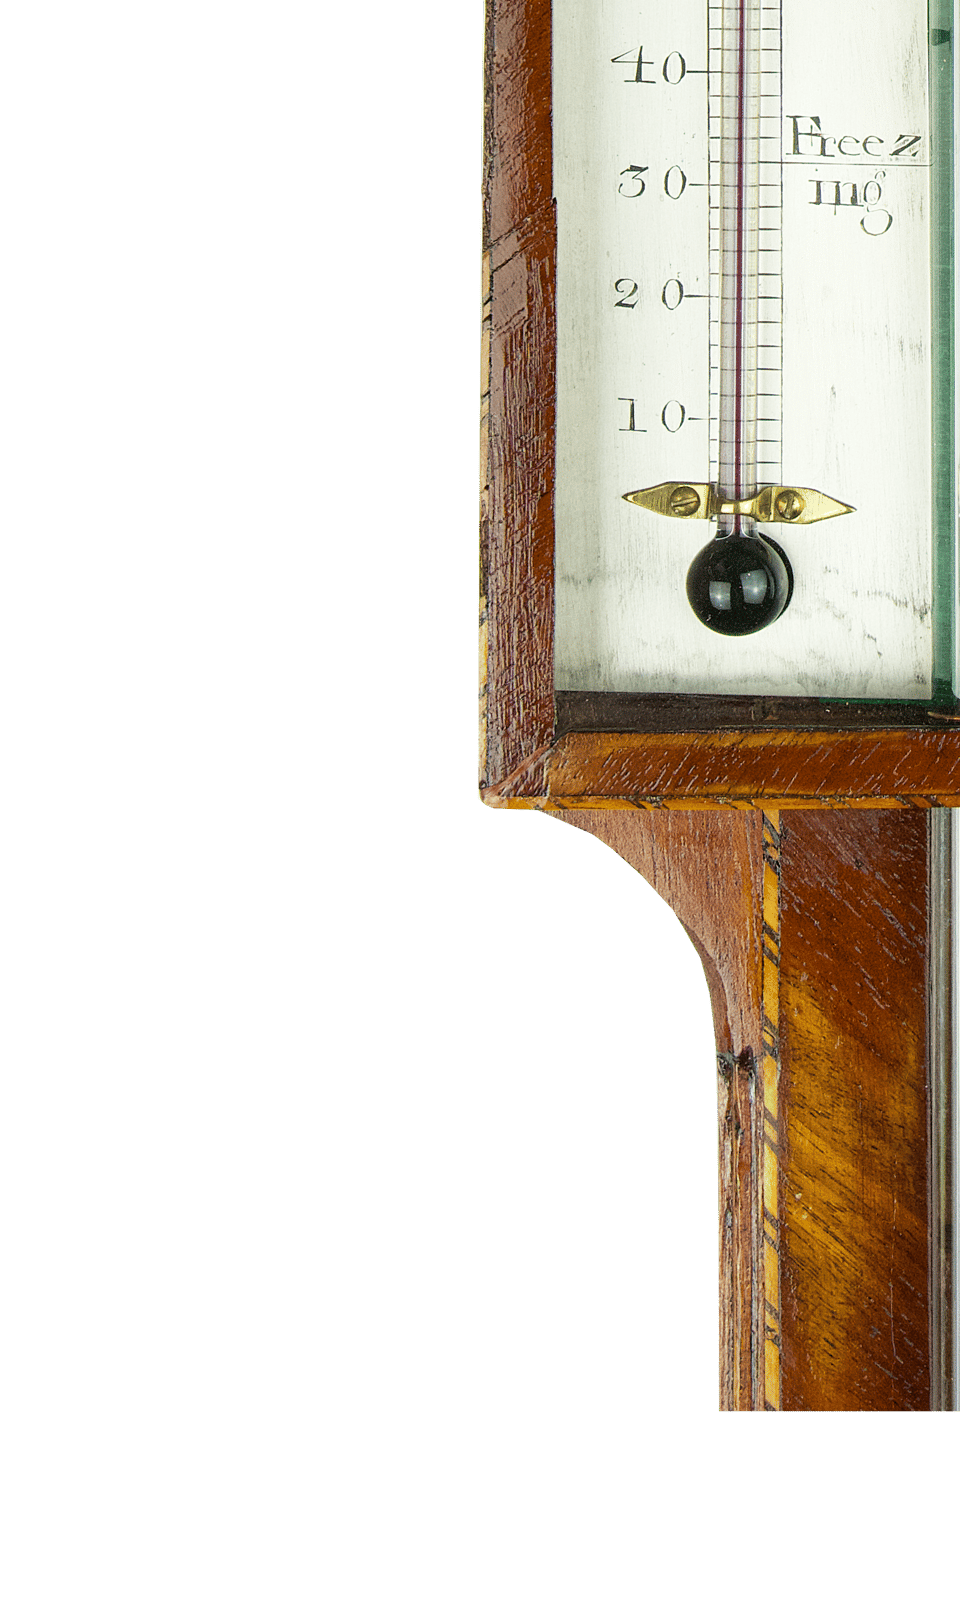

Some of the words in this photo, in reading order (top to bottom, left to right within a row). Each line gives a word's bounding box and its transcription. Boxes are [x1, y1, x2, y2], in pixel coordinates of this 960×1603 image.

[610, 45, 687, 86] 40
[785, 114, 922, 158] Freez
[618, 162, 687, 200] 30
[808, 168, 894, 237] ing
[613, 278, 684, 311] 20
[617, 396, 686, 434] 10
